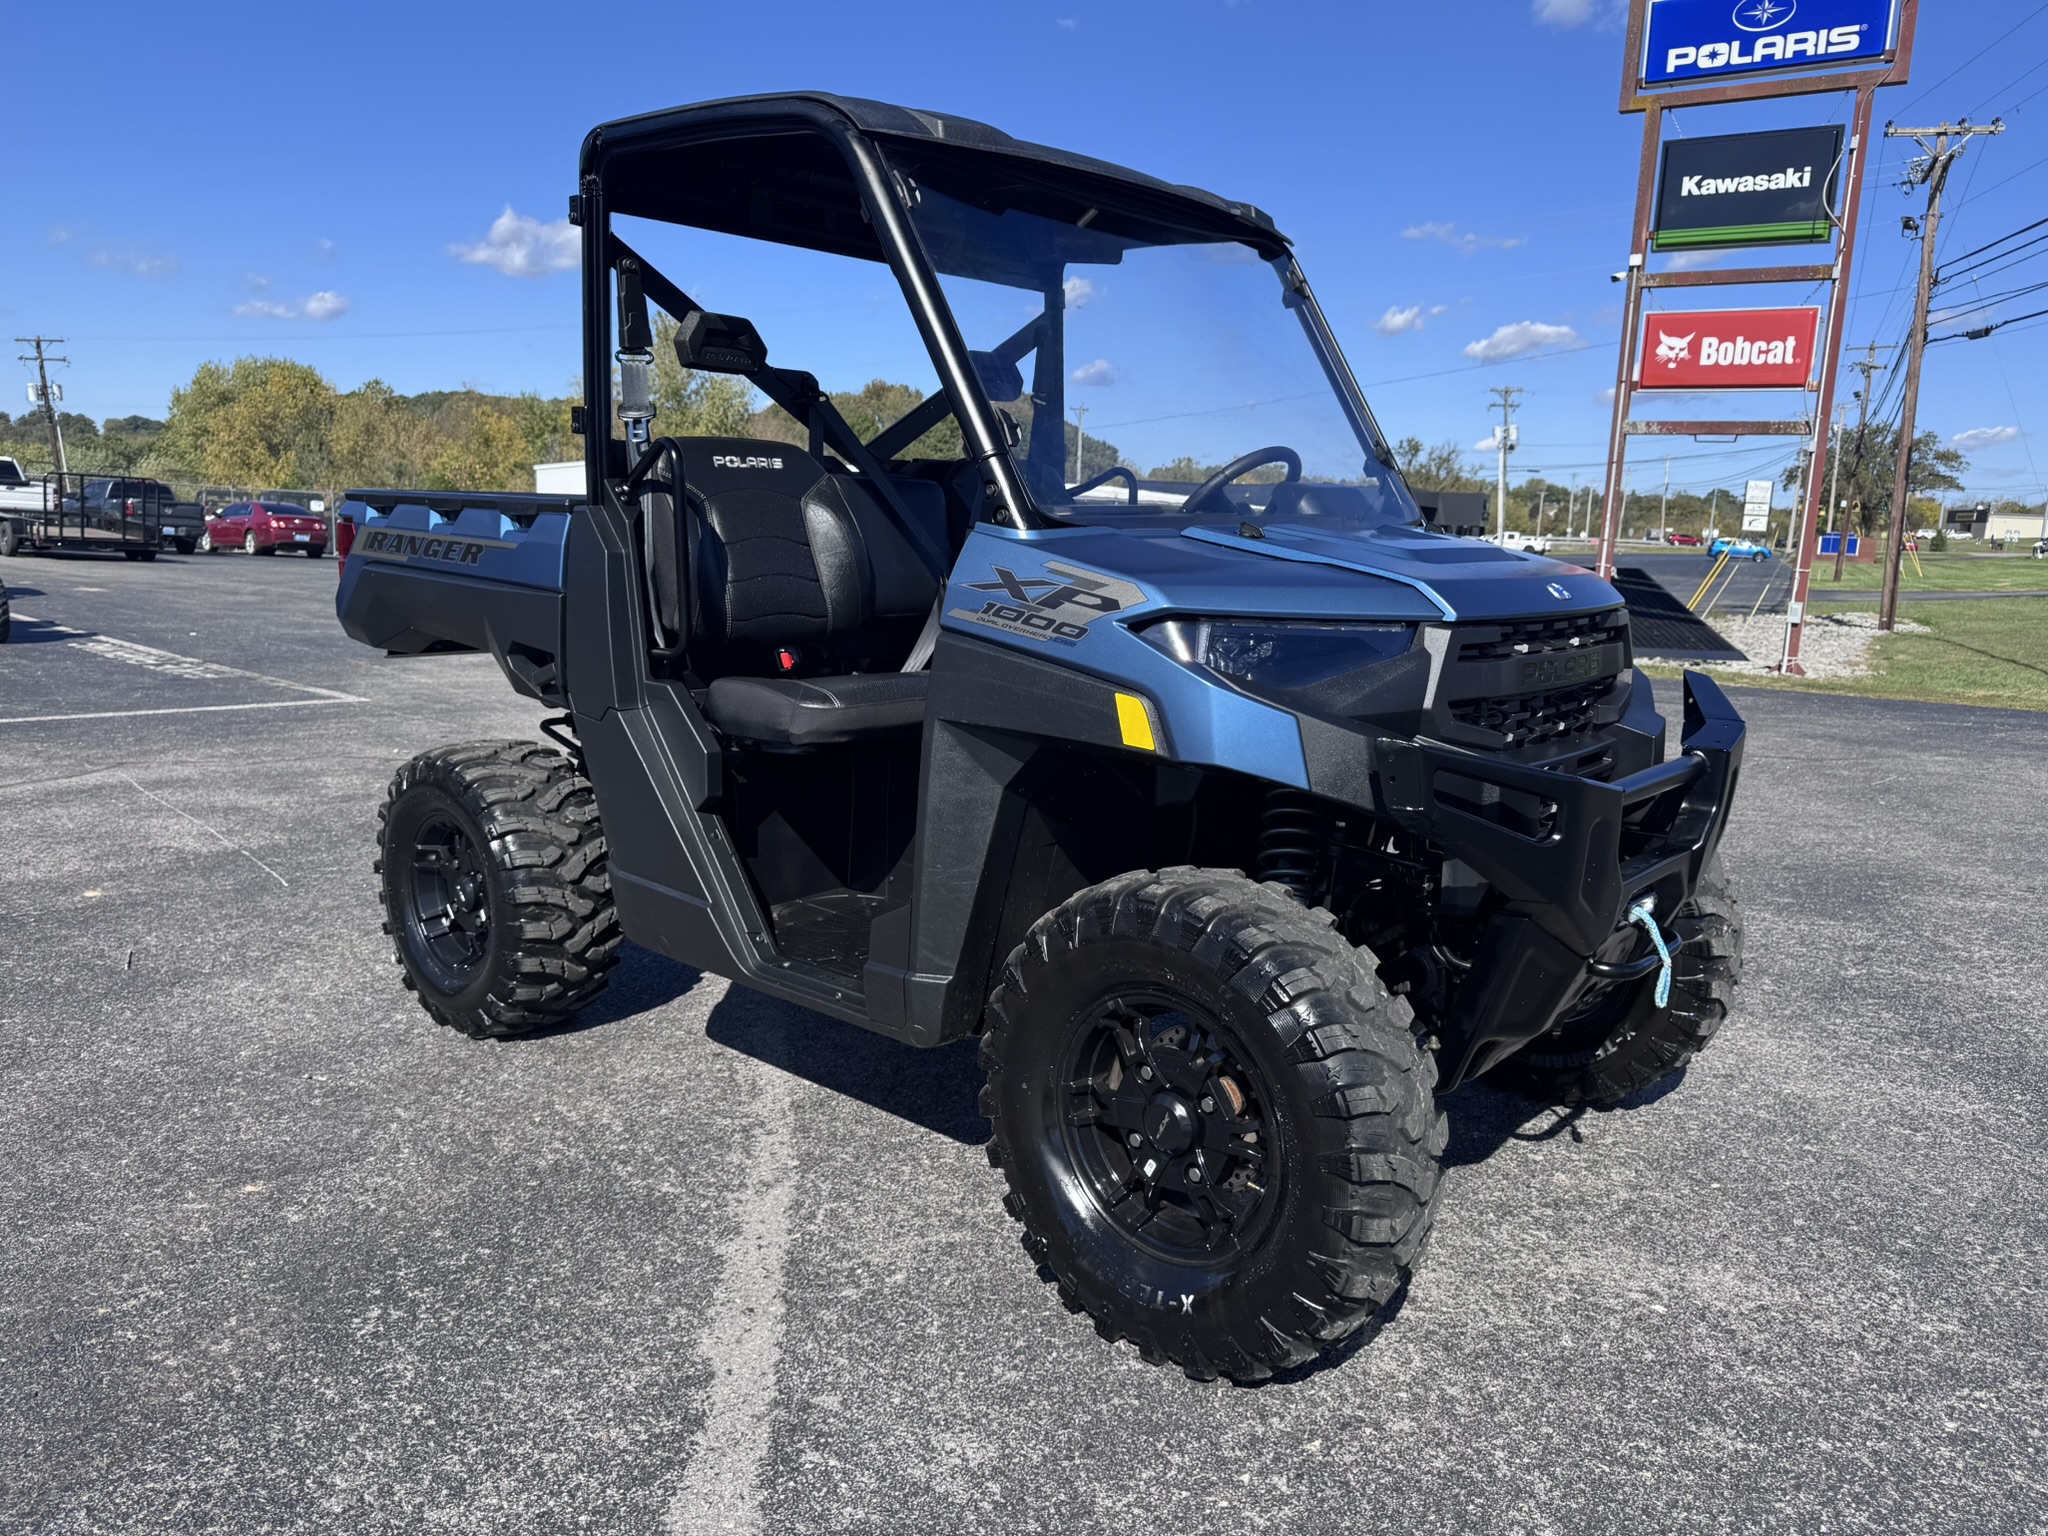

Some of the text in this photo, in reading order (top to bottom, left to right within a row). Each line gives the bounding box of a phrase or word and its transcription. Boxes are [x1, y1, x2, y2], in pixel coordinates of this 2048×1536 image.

[1666, 24, 1861, 73] POLARIS
[1681, 166, 1812, 196] Kawasaki
[1699, 336, 1797, 366] Bobcat
[712, 455, 784, 470] POLARIS
[364, 530, 485, 566] RANGER
[958, 564, 1123, 614] XP
[976, 616, 1078, 648] DUAL OVERHEAD CAM
[980, 600, 1091, 641] 1000
[1520, 651, 1600, 689] POLARIS
